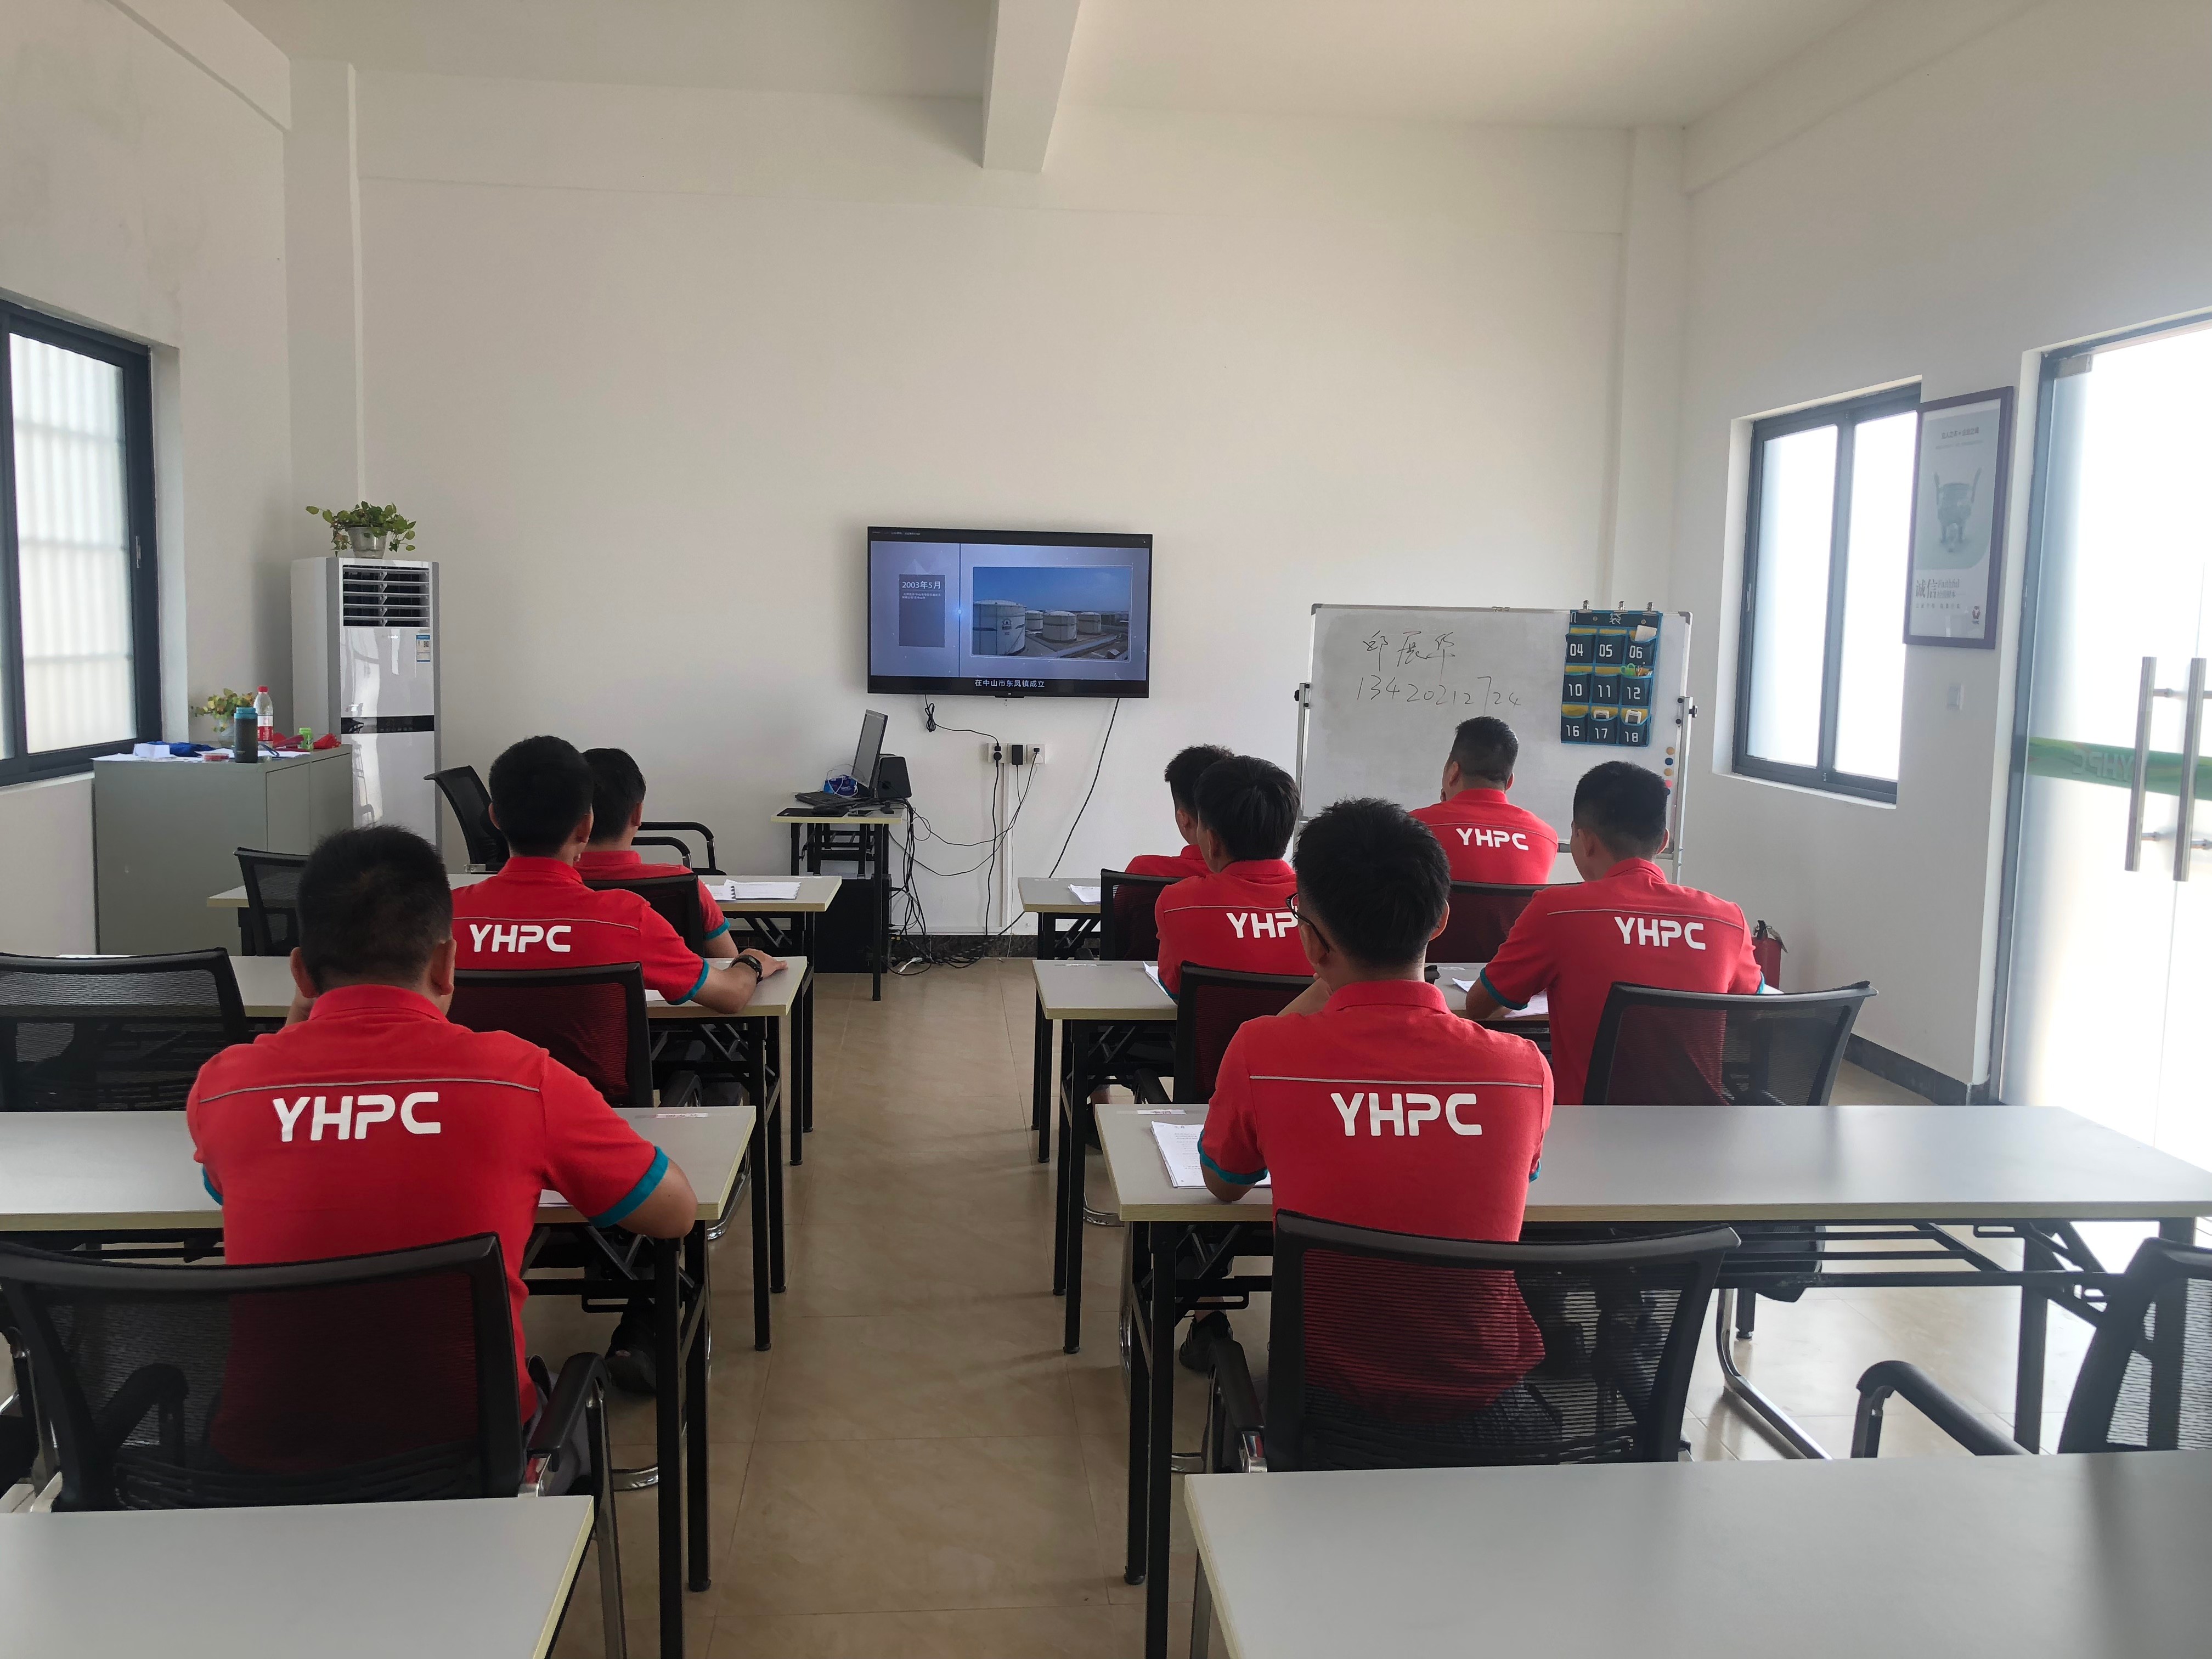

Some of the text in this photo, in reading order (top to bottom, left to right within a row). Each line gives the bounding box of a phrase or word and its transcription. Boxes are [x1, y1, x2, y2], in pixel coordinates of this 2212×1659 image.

[902, 580, 940, 589] 2003年5月
[1916, 579, 1938, 599] 诚信
[1570, 643, 1643, 659] 04 05 06
[975, 679, 1045, 687] 在中山市东凤镇成立
[1568, 684, 1640, 699] 10 11 12
[1566, 724, 1638, 742] 16 17 18
[1455, 827, 1530, 851] YHPC
[1226, 912, 1299, 938] YHP
[1613, 916, 1707, 951] YHPC
[469, 923, 572, 953] YHPC
[272, 1091, 442, 1143] YHPC
[1330, 1092, 1483, 1137] YHPC
